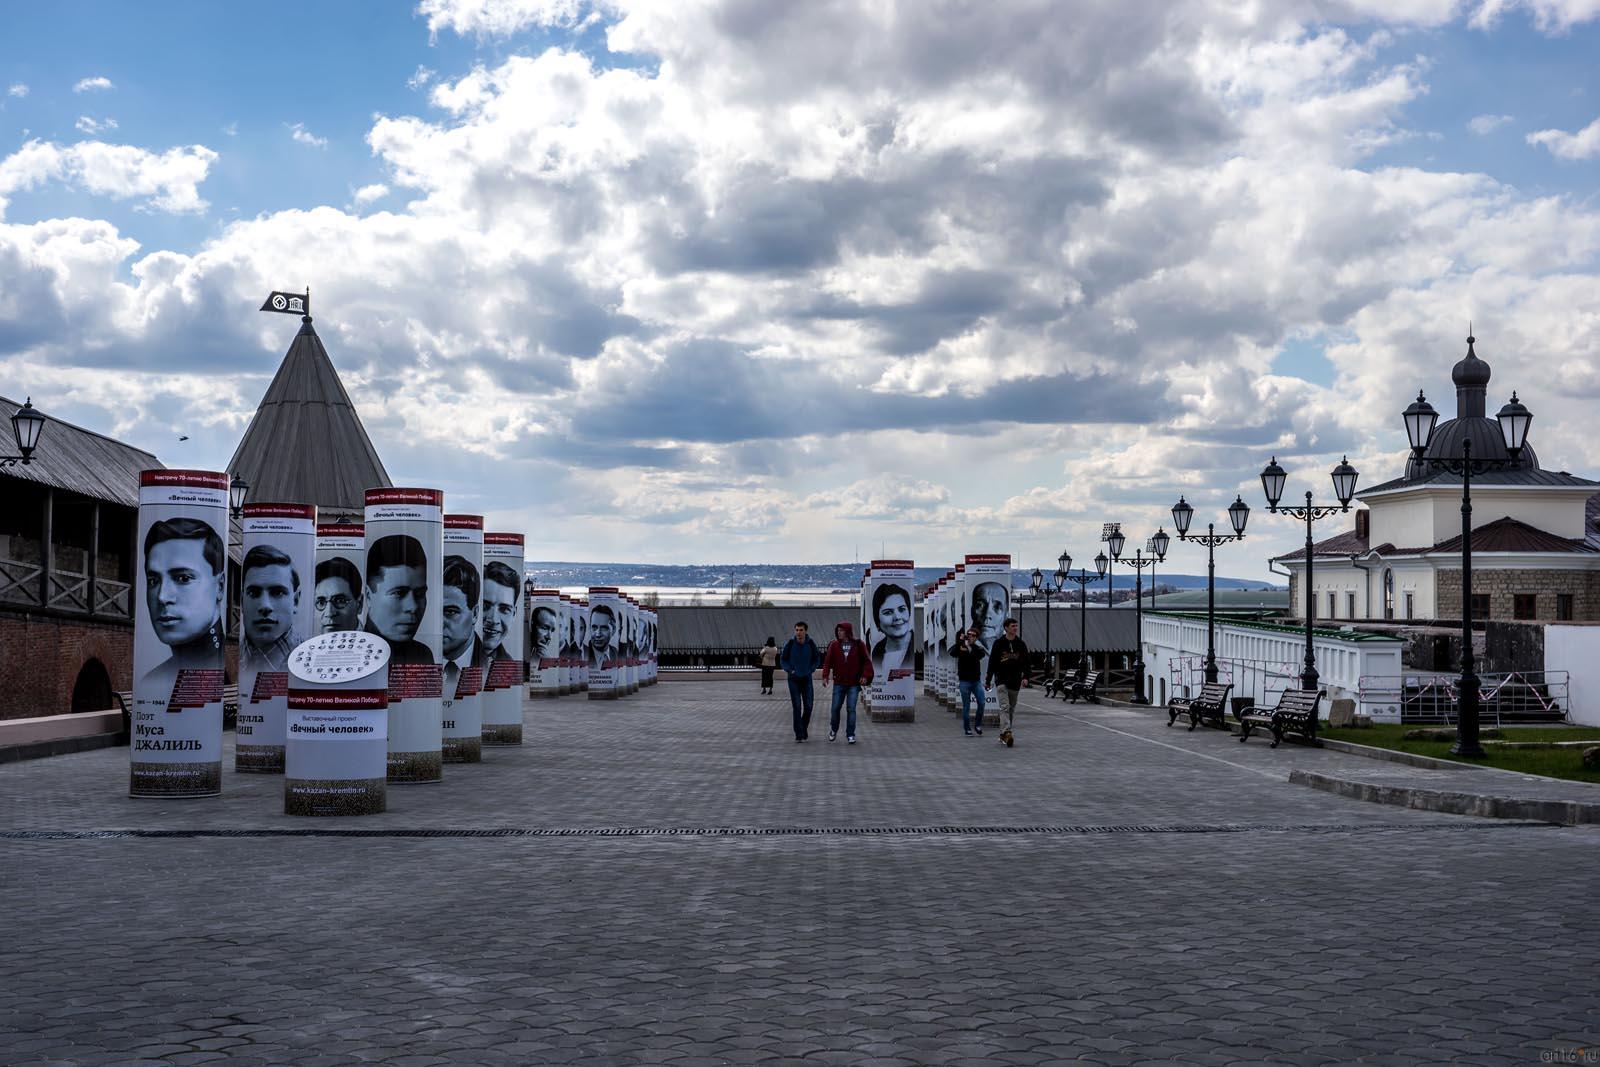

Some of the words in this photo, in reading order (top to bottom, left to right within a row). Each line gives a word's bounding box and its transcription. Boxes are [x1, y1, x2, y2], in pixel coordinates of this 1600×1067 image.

[306, 696, 334, 704] 70-летию
[334, 696, 360, 704] Великой
[136, 711, 155, 721] Поэт
[136, 724, 164, 737] Муса
[290, 723, 326, 734] «Вечный
[328, 725, 374, 734] человек»
[135, 740, 203, 752] ДЖАЛИЛЬ
[292, 786, 366, 794] www.kazan-kremlin.ru
